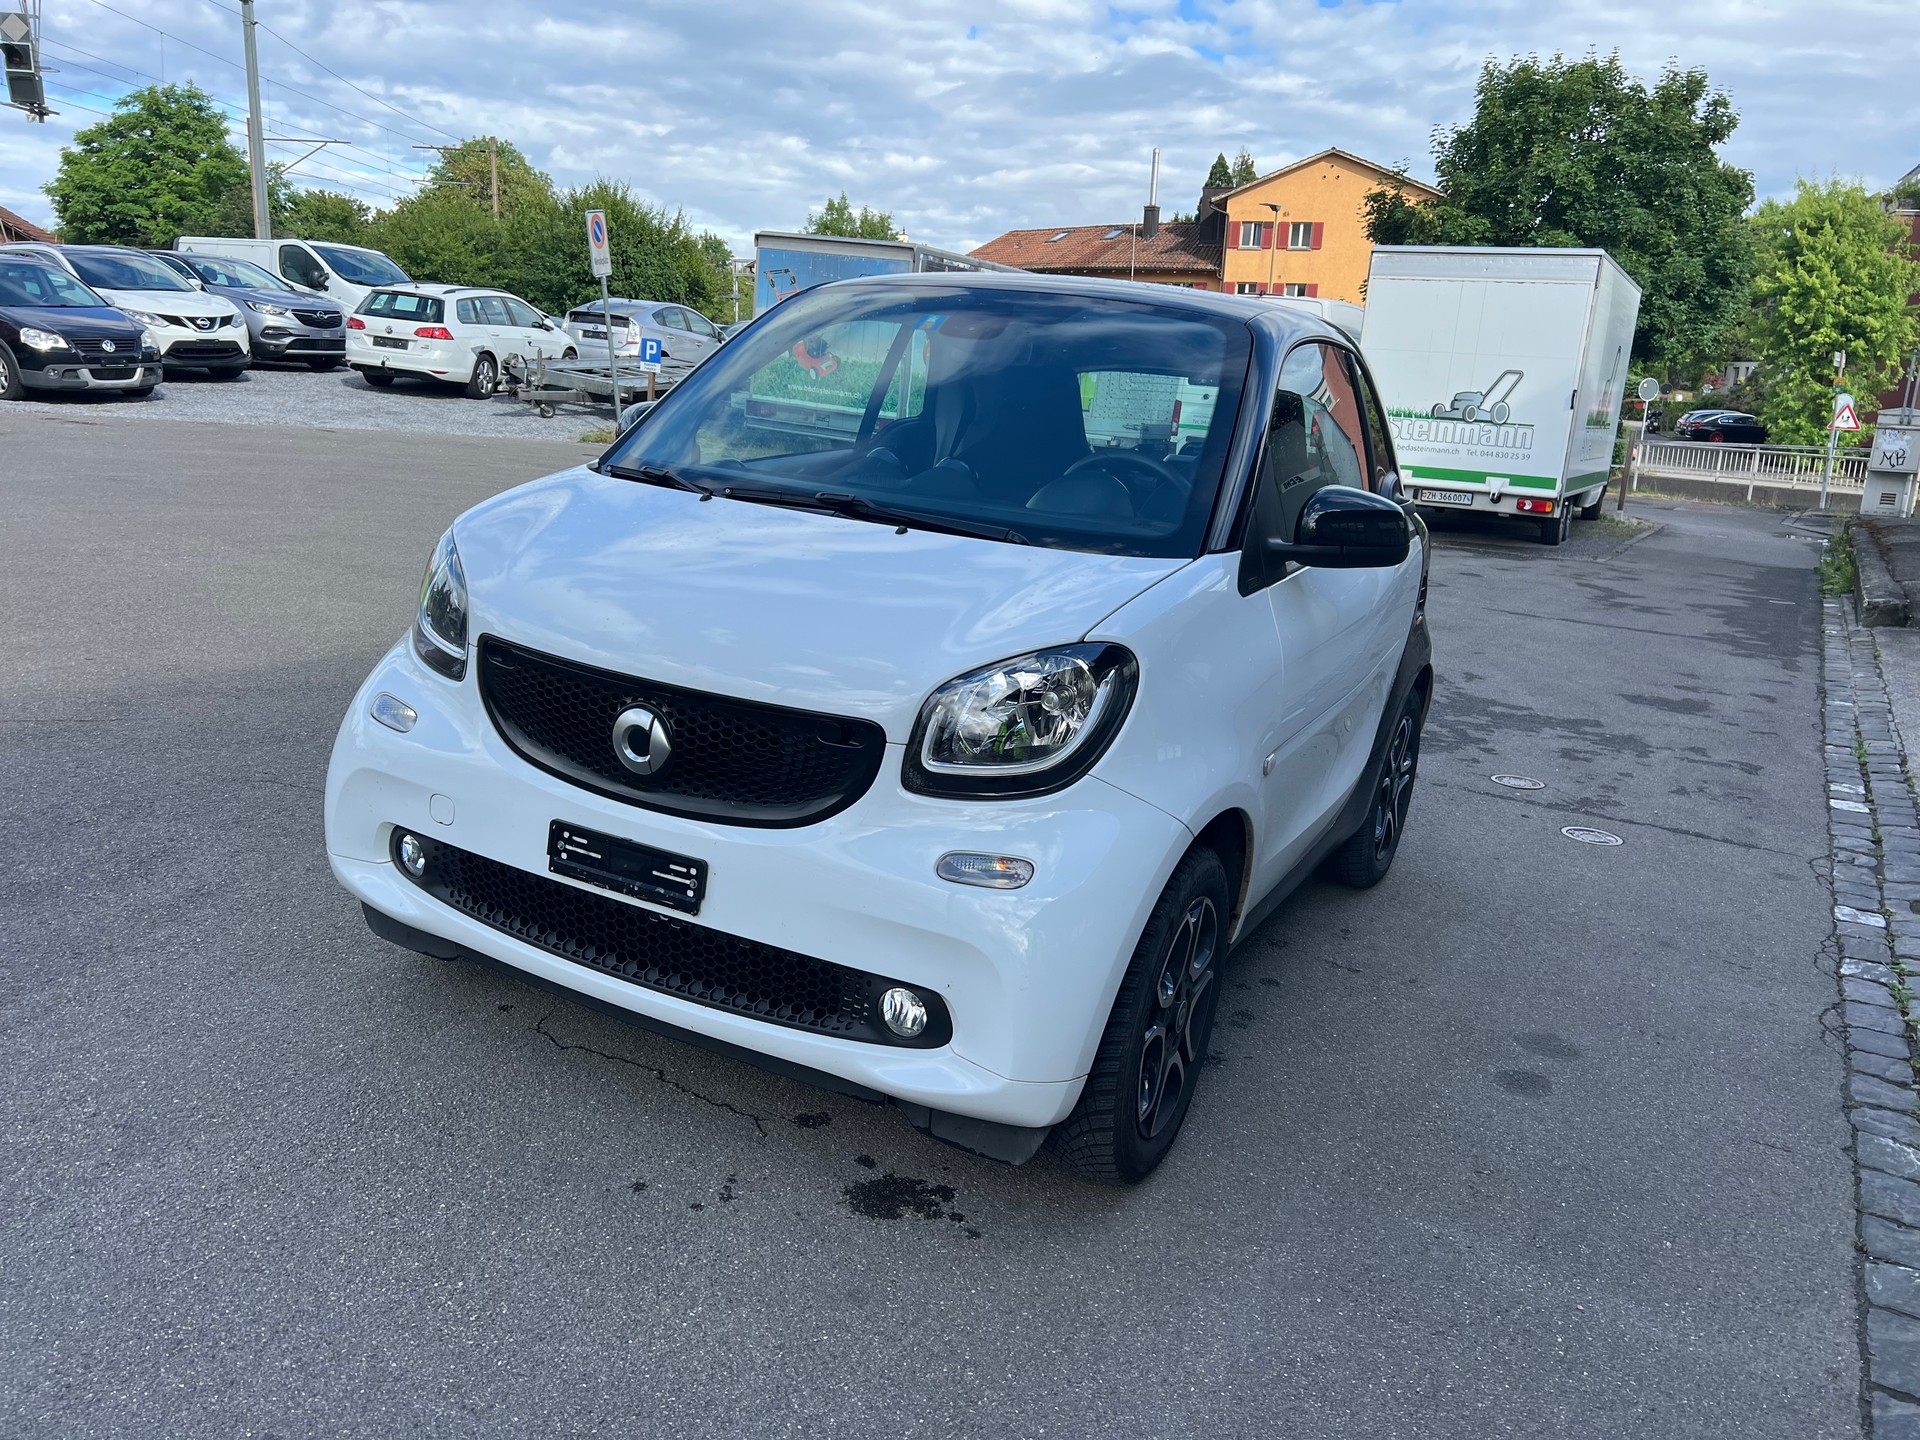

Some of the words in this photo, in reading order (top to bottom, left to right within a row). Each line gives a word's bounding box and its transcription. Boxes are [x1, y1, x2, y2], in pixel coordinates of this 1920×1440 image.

[646, 341, 657, 360] P
[1480, 450, 1494, 458] 044
[1495, 451, 1509, 459] 830
[1510, 452, 1520, 460] 25
[1521, 453, 1531, 461] 39
[1426, 491, 1437, 500] ZH
[1438, 492, 1466, 502] 366007
